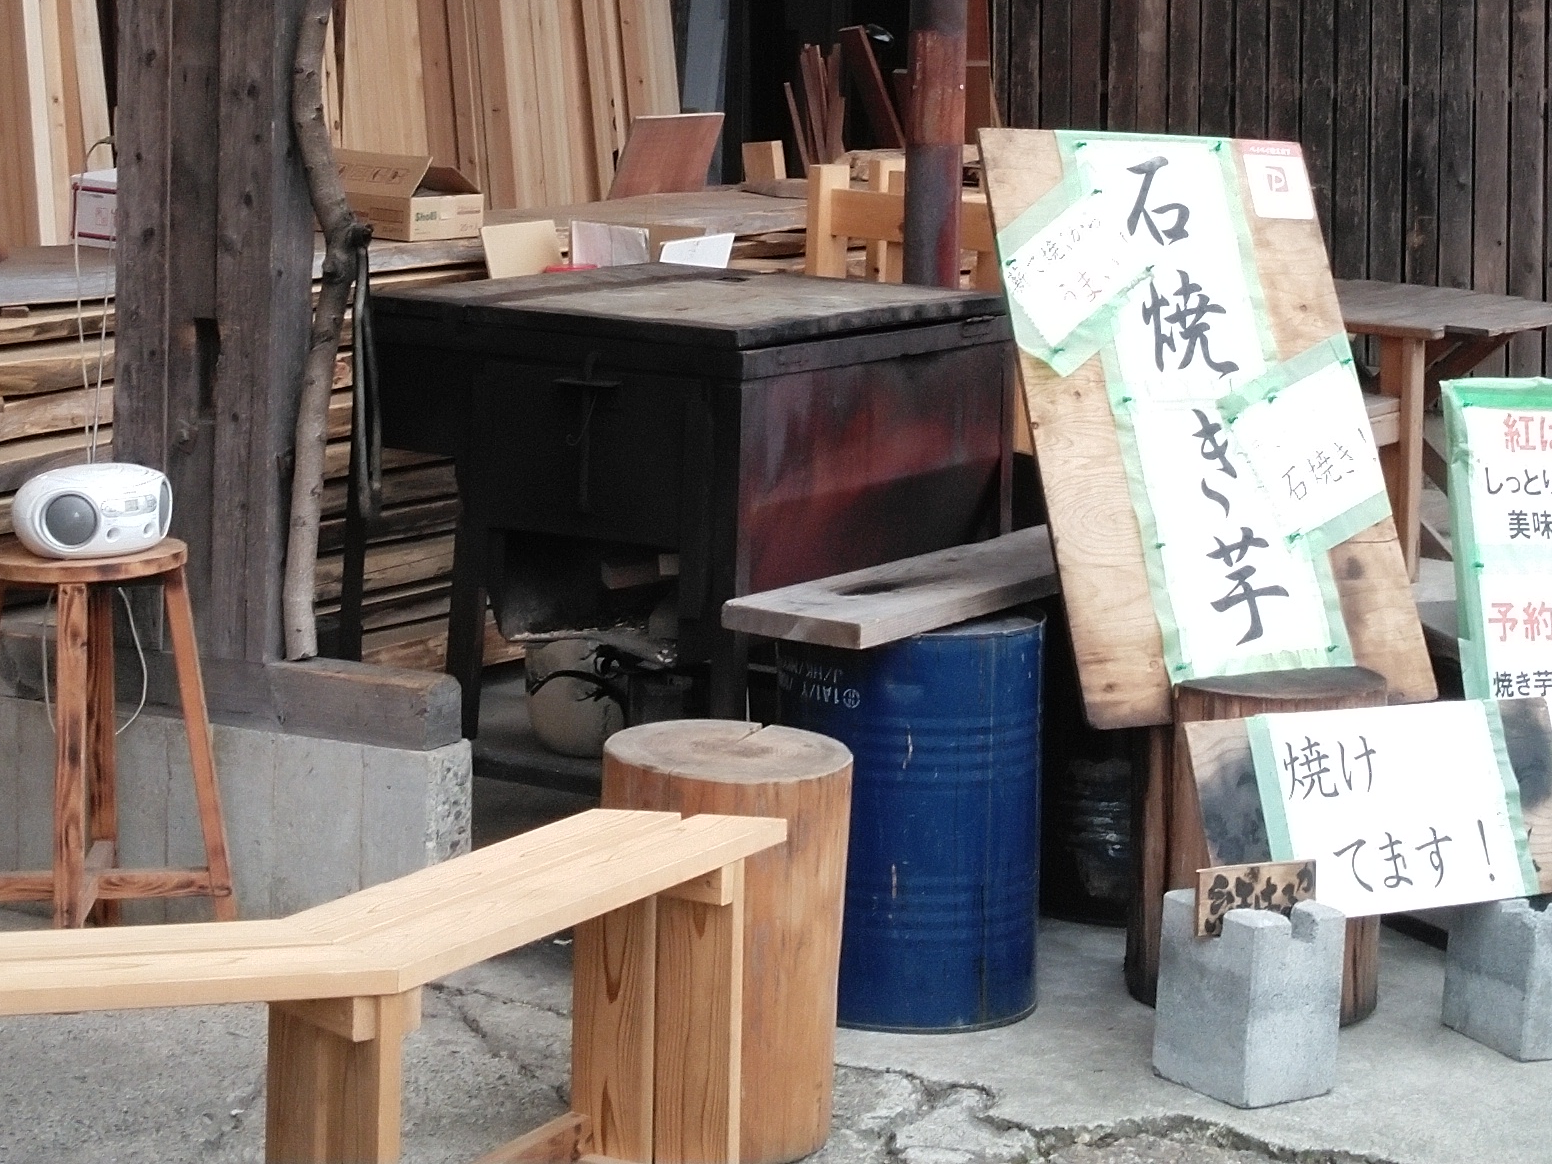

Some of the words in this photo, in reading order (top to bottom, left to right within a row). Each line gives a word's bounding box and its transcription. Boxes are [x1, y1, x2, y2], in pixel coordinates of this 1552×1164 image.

[1127, 155, 1290, 647] 石焼き芋
[1284, 735, 1377, 801] 焼け
[1333, 818, 1497, 893] てます！
